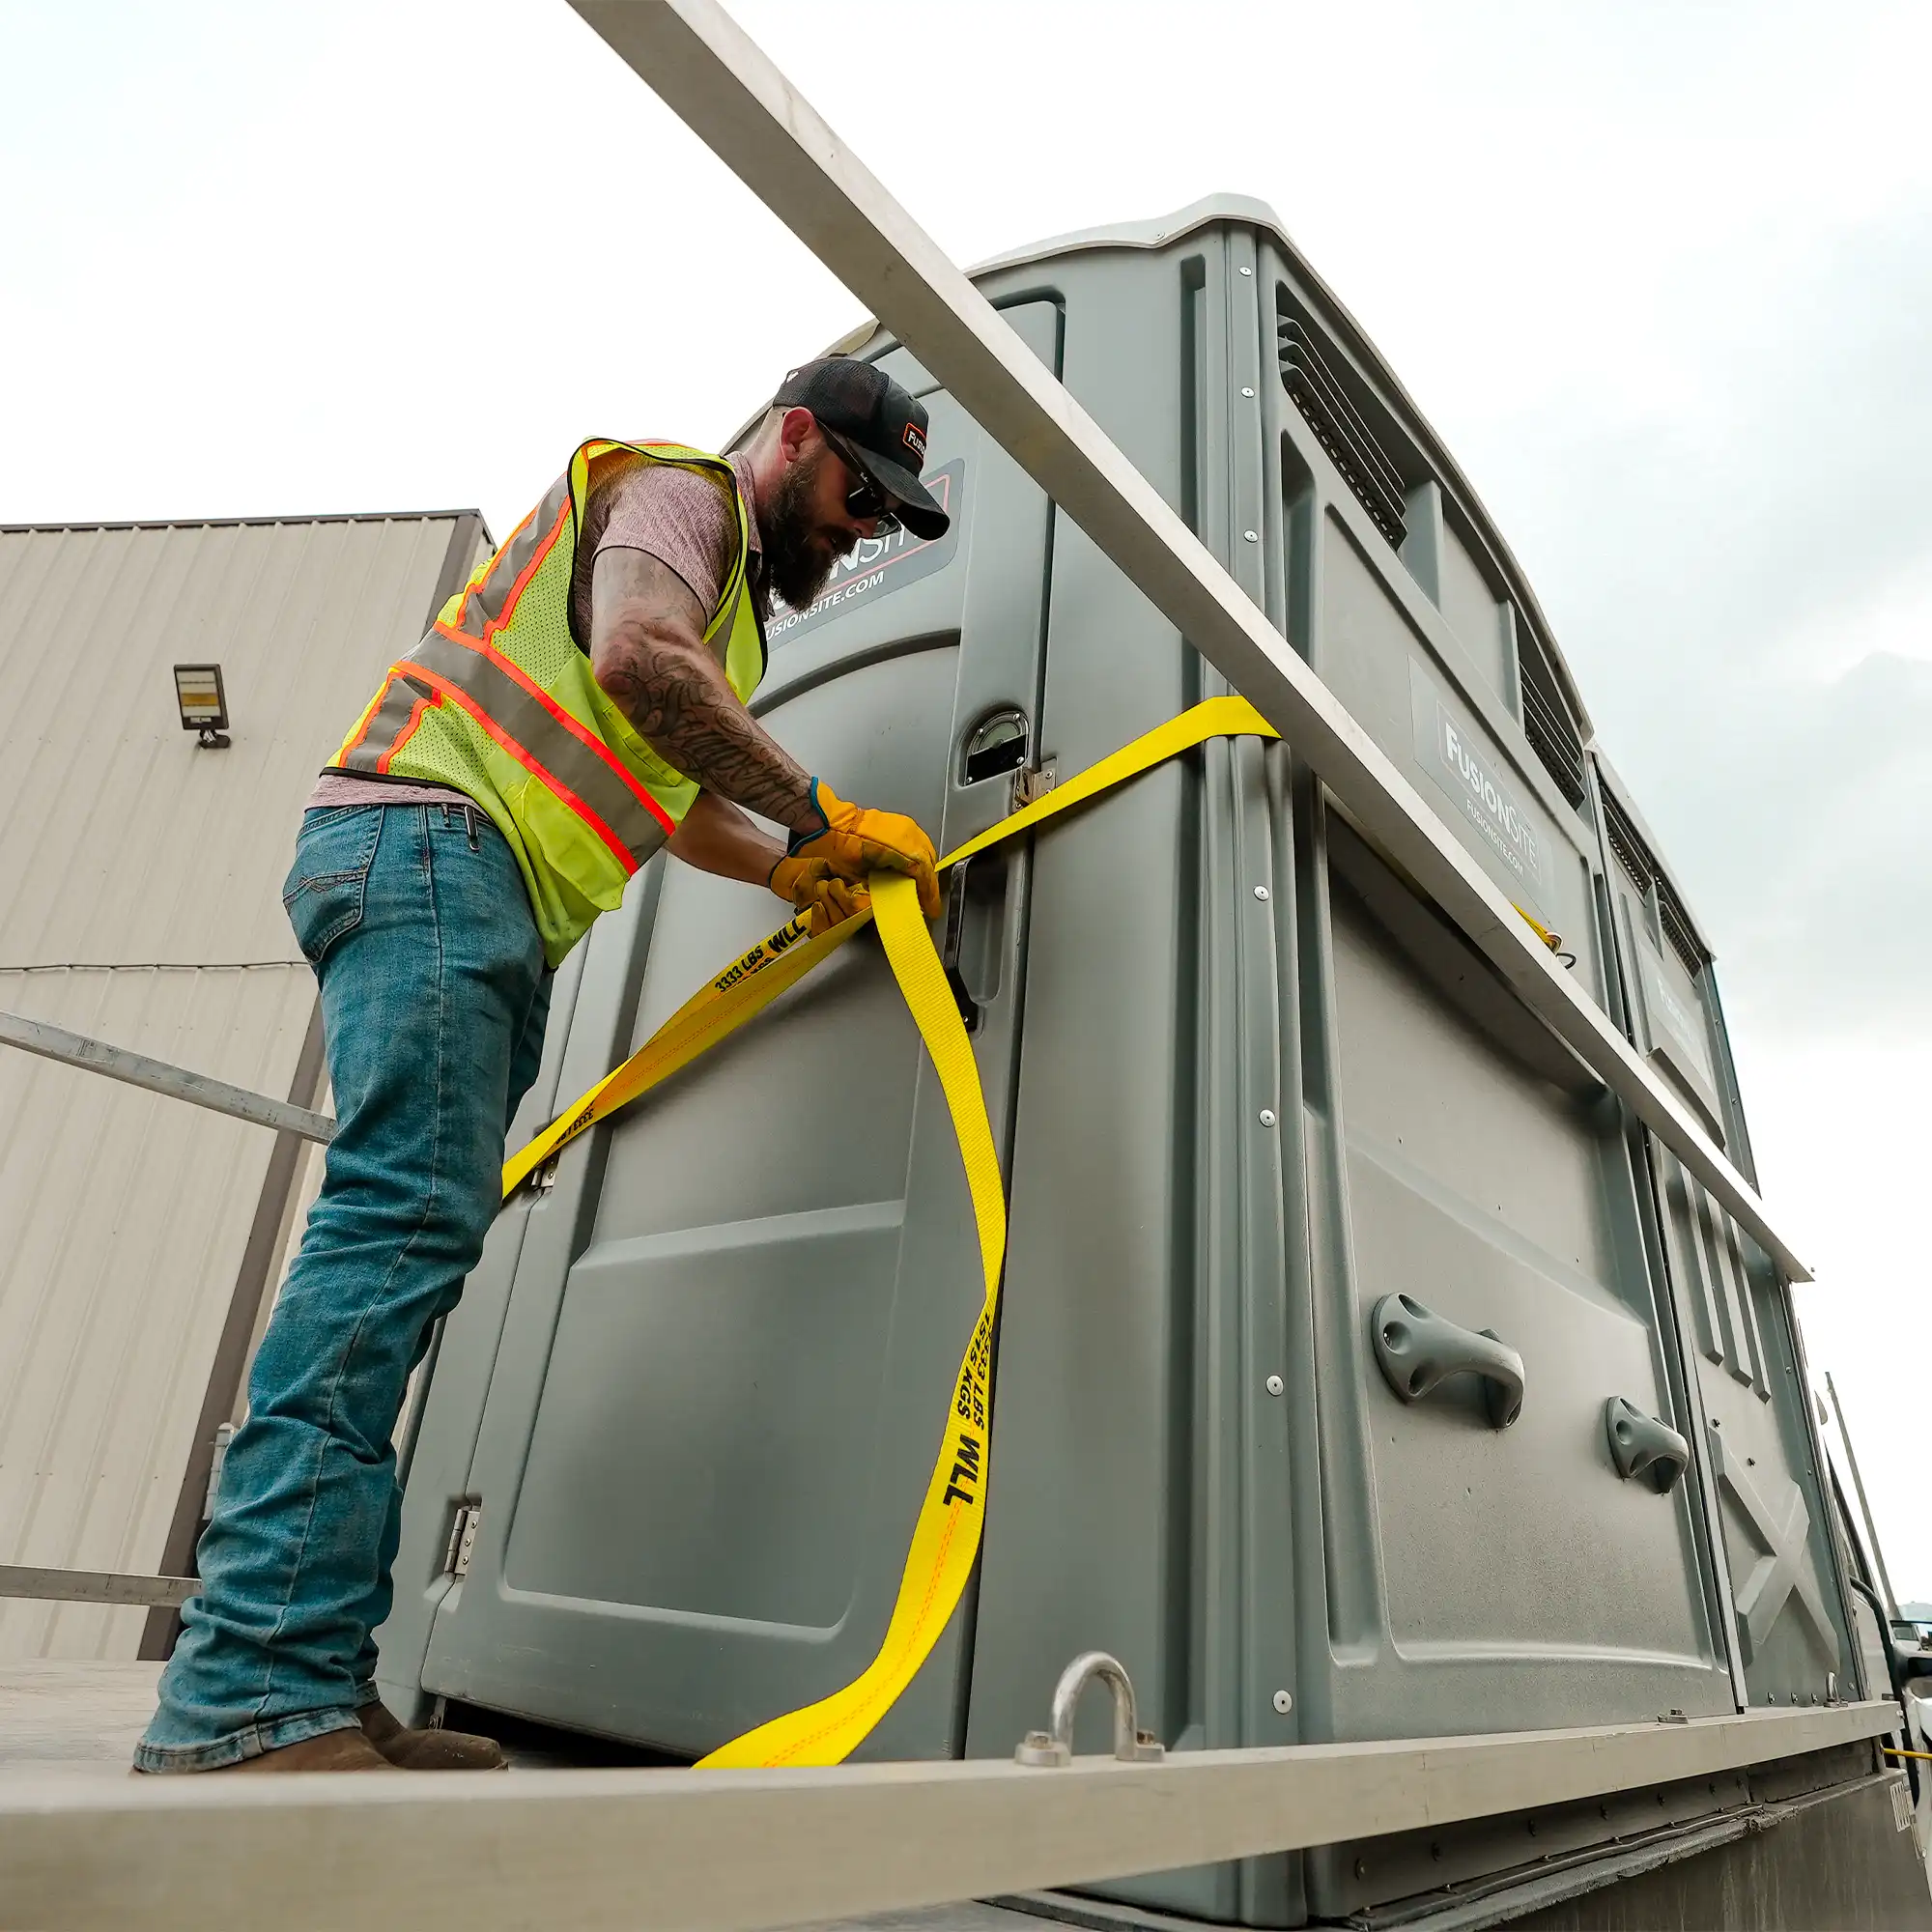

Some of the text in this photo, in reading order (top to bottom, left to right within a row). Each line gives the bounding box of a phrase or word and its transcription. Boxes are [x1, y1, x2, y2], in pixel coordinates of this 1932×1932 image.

[765, 571, 885, 640] USIONSITE.COM
[1466, 798, 1523, 878] FUSIONSITE.COM
[767, 918, 808, 953] WLL
[715, 965, 744, 993] 3333
[741, 945, 764, 972] LBS
[957, 1366, 973, 1420] KGS
[973, 1381, 985, 1430] LBS
[943, 1434, 980, 1506] WLL
